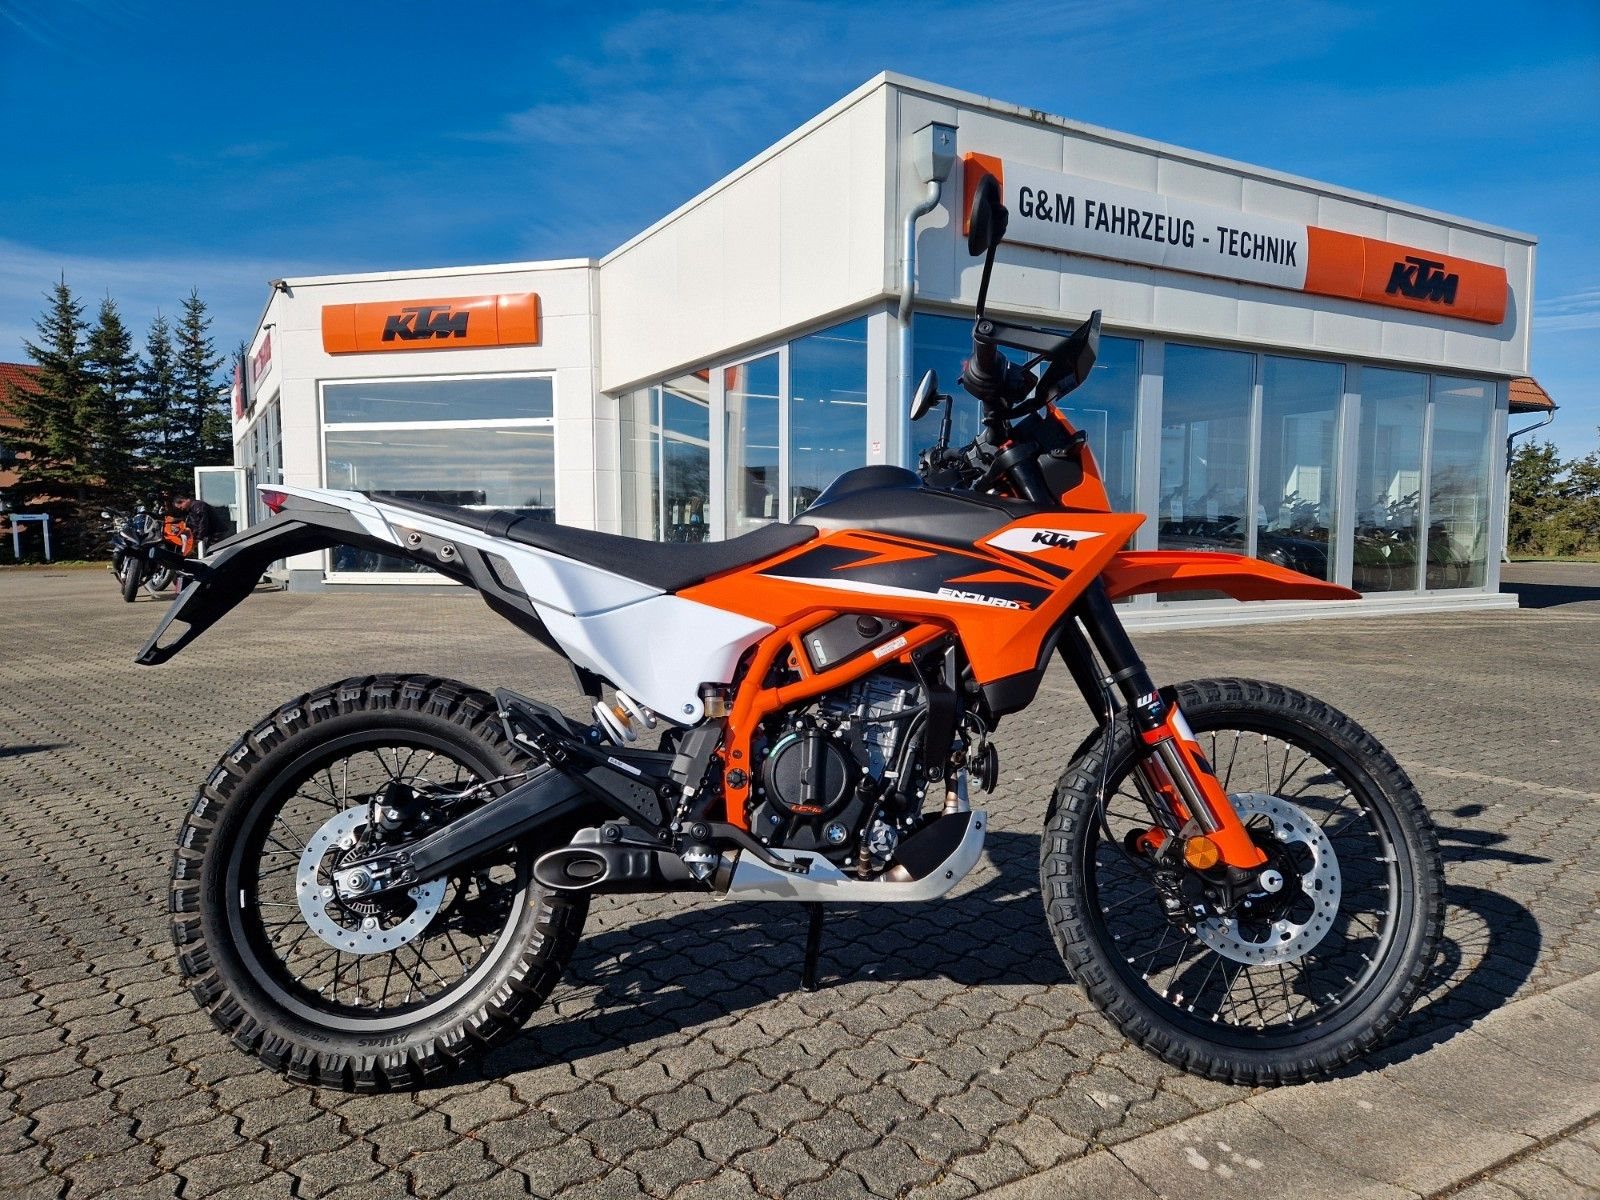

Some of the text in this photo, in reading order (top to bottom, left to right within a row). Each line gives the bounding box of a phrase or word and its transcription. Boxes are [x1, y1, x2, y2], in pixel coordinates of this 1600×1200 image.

[1018, 186, 1075, 226] G&M
[1085, 199, 1195, 249] FAHRZEUG
[1216, 226, 1298, 267] TECHNIK
[1385, 256, 1458, 304] KTM
[381, 305, 470, 342] KTM
[1031, 530, 1079, 551] KTM
[937, 587, 1020, 610] ENDURO
